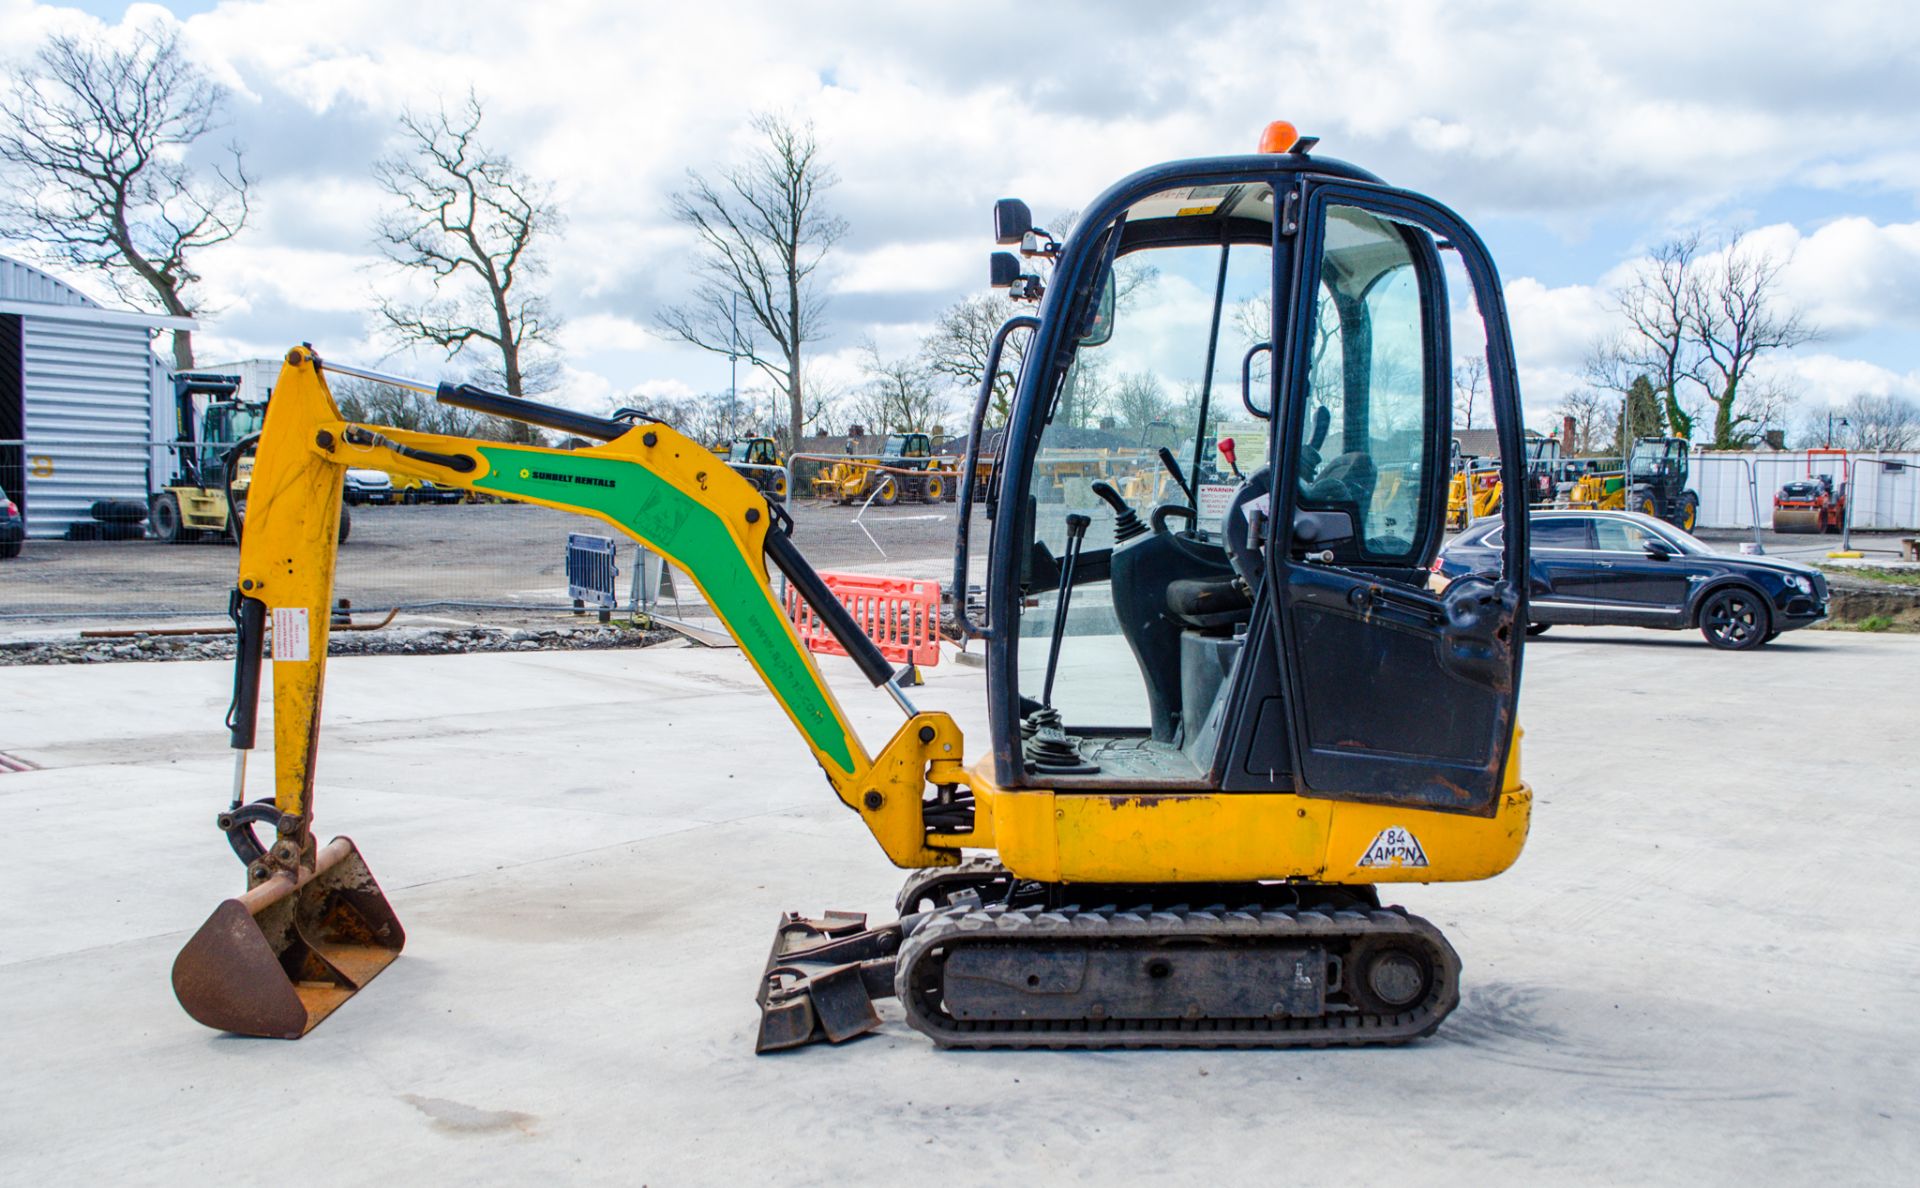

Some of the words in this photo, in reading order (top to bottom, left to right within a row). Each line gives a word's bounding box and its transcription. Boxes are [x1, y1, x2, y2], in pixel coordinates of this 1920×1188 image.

[532, 471, 573, 483] SUNBELT
[575, 475, 616, 488] RENTALS
[1387, 830, 1405, 845] 84
